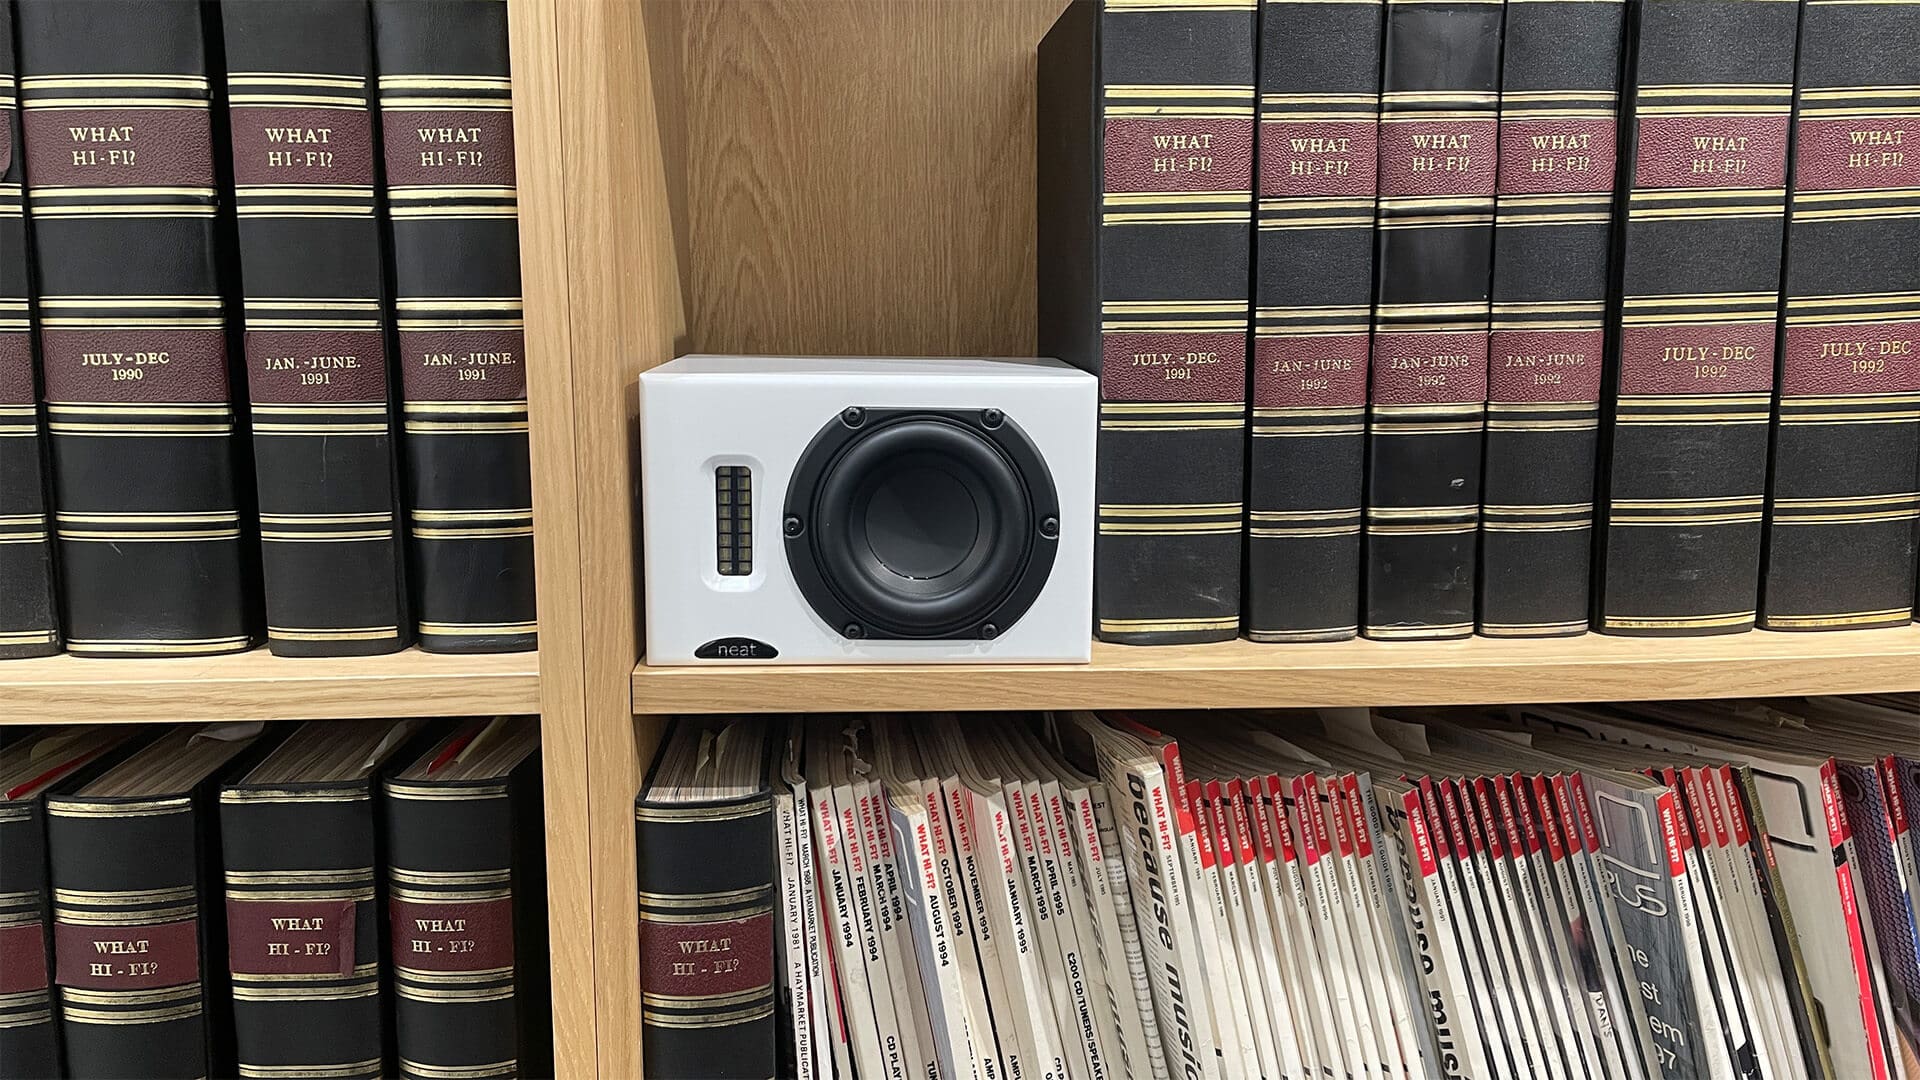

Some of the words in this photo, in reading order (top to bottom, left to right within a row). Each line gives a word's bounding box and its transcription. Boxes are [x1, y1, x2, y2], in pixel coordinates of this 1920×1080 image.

[69, 126, 134, 143] WHAT
[264, 127, 332, 144] WHAT
[417, 127, 482, 144] WHAT
[1153, 134, 1213, 149] WHAT
[1290, 138, 1350, 153] WHAT
[1412, 134, 1471, 149] WHAT
[1531, 134, 1591, 149] WHAT
[1692, 136, 1749, 151] WHAT
[1850, 131, 1905, 145] WHAT
[111, 368, 144, 382] 1990
[300, 371, 331, 386] 1991
[458, 369, 487, 381] 1991
[1165, 369, 1191, 380] 1991
[1534, 374, 1561, 385] 1992
[1695, 365, 1727, 379] 1992
[1851, 359, 1885, 373] 1992
[1300, 379, 1329, 390] 1992
[1418, 375, 1446, 387] 1992
[718, 643, 757, 656] neat
[1171, 756, 1184, 784] WHAT
[1186, 834, 1199, 864] JANUARY
[1213, 796, 1224, 824] WHAT
[1231, 794, 1243, 821] WHAT
[1254, 793, 1266, 820] WHAT
[1272, 791, 1285, 819] WHAT
[1296, 794, 1308, 822] WHAT
[1308, 785, 1320, 813] WHAT
[1329, 787, 1340, 815] WHAT
[1348, 788, 1360, 815] WHAT
[1364, 789, 1373, 804] THE
[870, 795, 883, 826] WHAT
[1194, 797, 1206, 824] WHAT
[1368, 805, 1379, 830] GOOD
[1411, 807, 1423, 834] WHAT
[1049, 795, 1063, 827] WHAT
[1066, 861, 1074, 874] MAY
[1079, 799, 1093, 830] WHAT
[1094, 866, 1103, 881] JULY
[1151, 786, 1165, 818] WHAT
[1164, 854, 1179, 893] SEPTEMBER
[801, 843, 810, 867] MARCH
[859, 796, 872, 828] WHAT
[872, 864, 887, 904] MARCH
[880, 905, 892, 931] 1994
[926, 792, 940, 823] WHAT
[939, 858, 958, 909] OCTOBER
[951, 910, 963, 936] 1994
[950, 789, 964, 821] WHAT
[965, 855, 984, 914] NOVEMBER
[978, 915, 990, 940] 1994
[1011, 790, 1026, 821] WHAT
[1026, 855, 1042, 894] MARCH
[1035, 895, 1049, 920] 1995
[1029, 792, 1043, 824] WHAT
[1045, 858, 1058, 889] APRIL
[1052, 890, 1064, 915] 1995
[1378, 849, 1389, 872] GUIDE
[1661, 808, 1674, 835] WHAT
[1677, 879, 1687, 910] FEBRUARY
[819, 800, 832, 831] WHAT
[831, 868, 848, 919] JANUARY
[841, 921, 853, 947] 1994
[842, 808, 856, 840] WHAT
[855, 876, 873, 932] FEBRUARY
[866, 935, 878, 961] 1994
[884, 862, 897, 893] APRIL
[786, 876, 798, 923] JANUARY
[890, 895, 902, 921] 1994
[916, 824, 929, 856] WHAT
[928, 894, 944, 938] AUGUST
[937, 940, 949, 966] 1994
[271, 918, 324, 931] WHAT
[415, 919, 466, 932] WHAT
[805, 895, 815, 933] HAYMARKET
[1006, 877, 1023, 926] JANUARY
[1016, 928, 1028, 953] 1995
[1126, 772, 1174, 951] because
[1165, 962, 1202, 1080] music
[93, 941, 149, 954] WHAT
[678, 938, 731, 954] WHAT
[791, 928, 800, 950] 1981
[809, 936, 819, 977] PUBLICATION
[1065, 952, 1080, 979] £200
[793, 971, 806, 1031] HAYMARKET
[885, 1035, 897, 1050] CD
